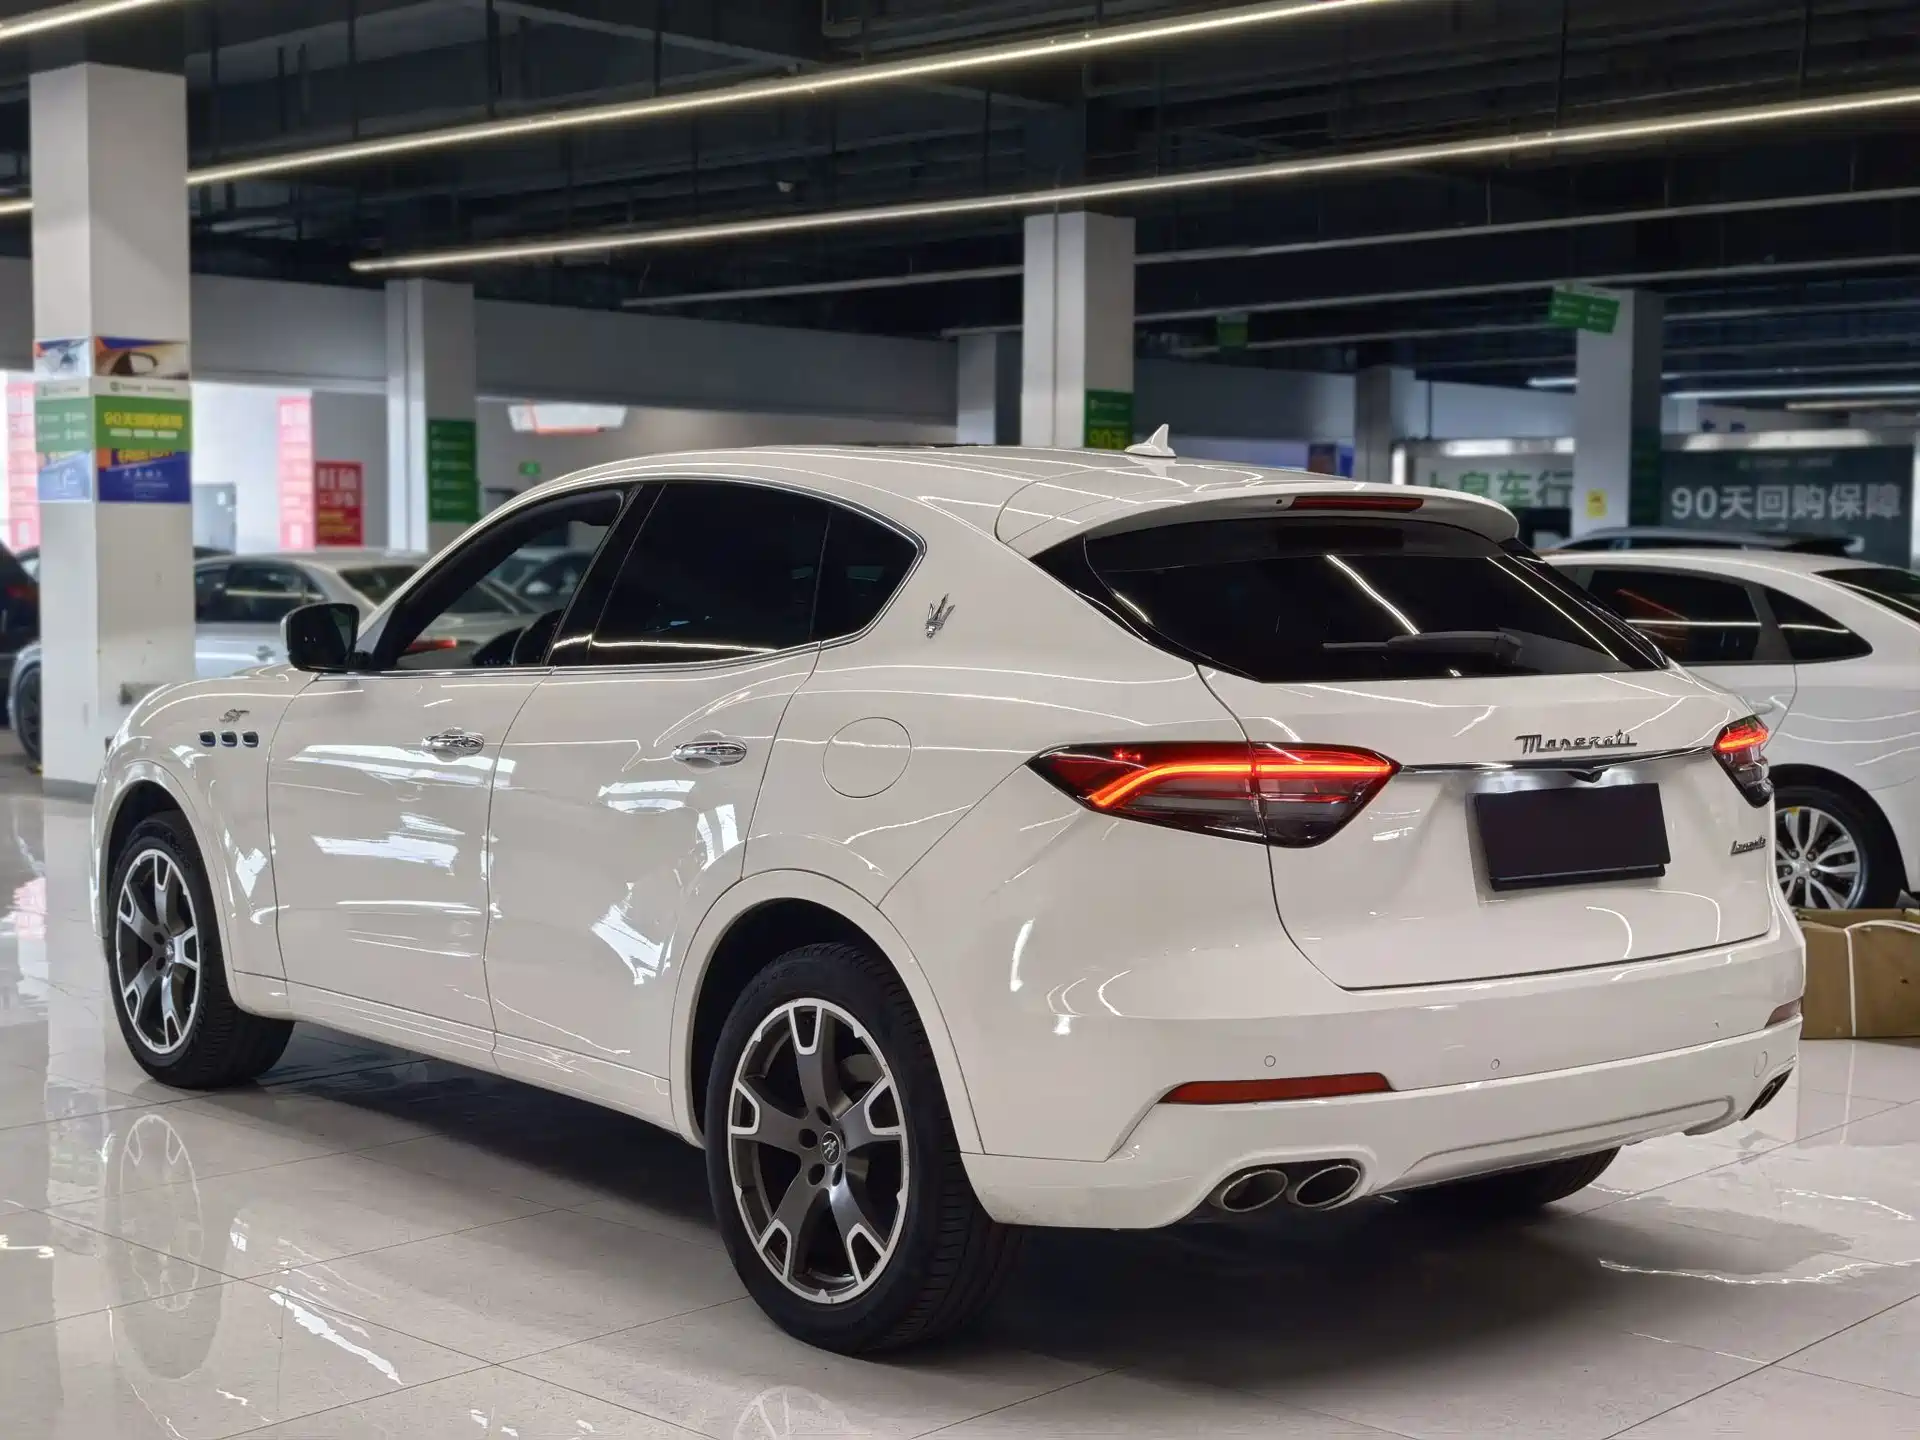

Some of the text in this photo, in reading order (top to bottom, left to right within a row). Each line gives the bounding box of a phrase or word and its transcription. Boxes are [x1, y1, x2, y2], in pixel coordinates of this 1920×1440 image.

[1671, 483, 1901, 520] 90天回购保障
[1515, 729, 1637, 754] Maserati
